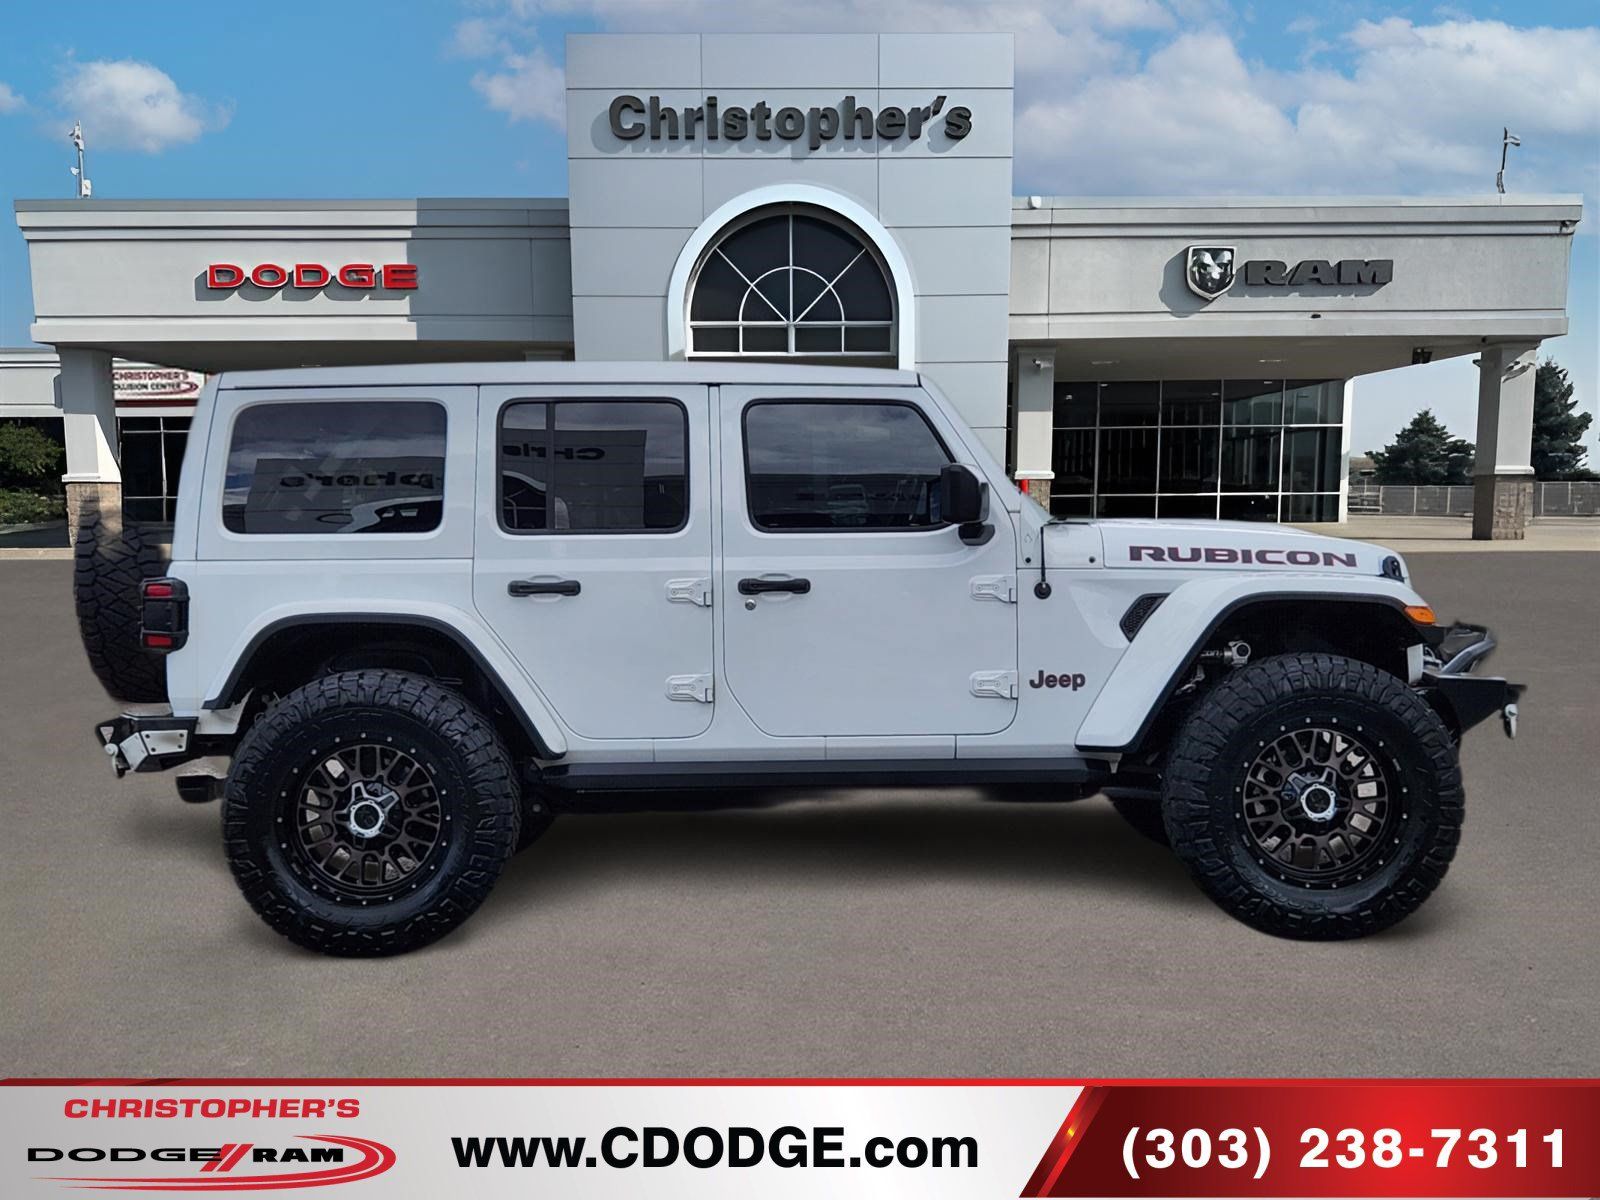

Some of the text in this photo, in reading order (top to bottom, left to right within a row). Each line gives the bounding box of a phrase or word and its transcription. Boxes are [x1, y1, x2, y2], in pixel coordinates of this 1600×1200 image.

[608, 95, 972, 150] Christopher's
[207, 264, 418, 289] DODGE
[1245, 259, 1394, 285] RAM
[150, 382, 181, 390] CENTER
[1129, 545, 1357, 568] RUBICON
[1029, 669, 1086, 691] Jeep
